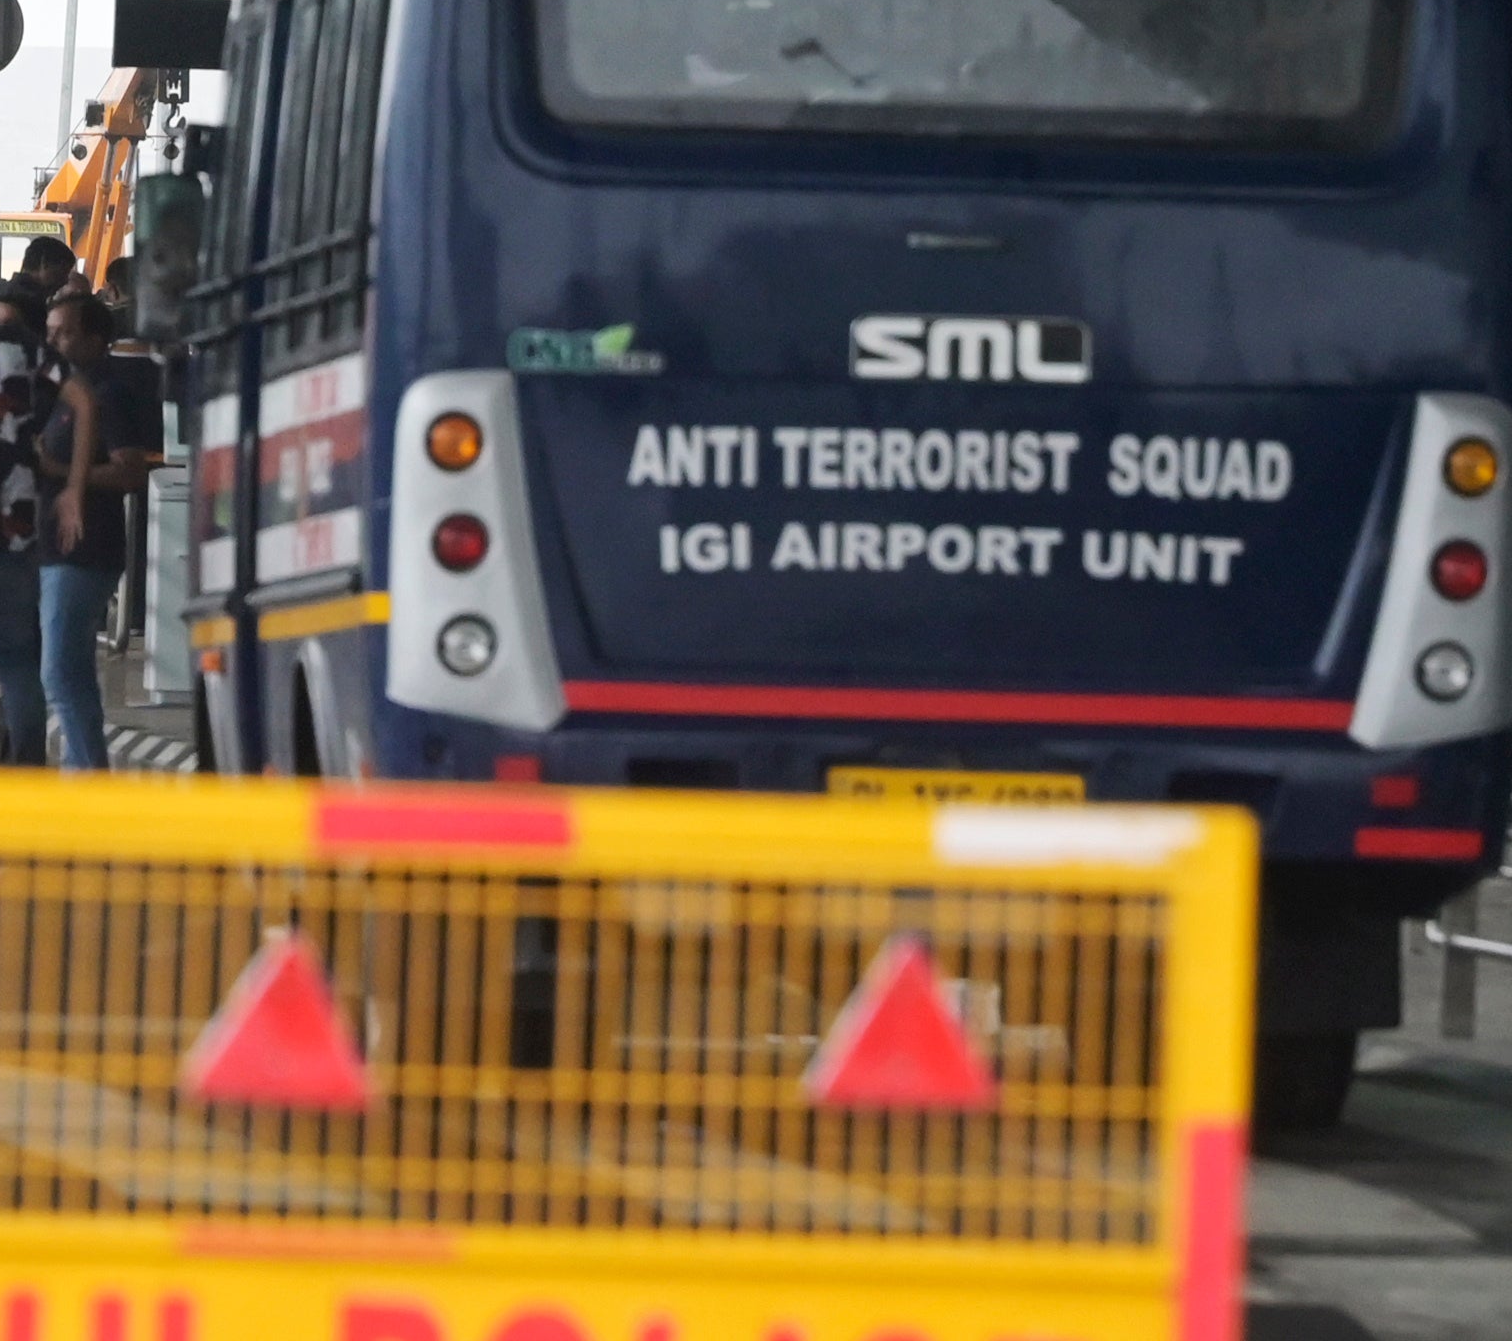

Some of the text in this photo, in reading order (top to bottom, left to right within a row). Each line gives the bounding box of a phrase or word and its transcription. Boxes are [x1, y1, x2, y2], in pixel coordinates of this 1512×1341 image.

[853, 317, 1089, 384] SML
[627, 425, 1293, 503] ANTI TERRORIST SQUAD
[658, 522, 1245, 587] IGI AIRPORT UNIT
